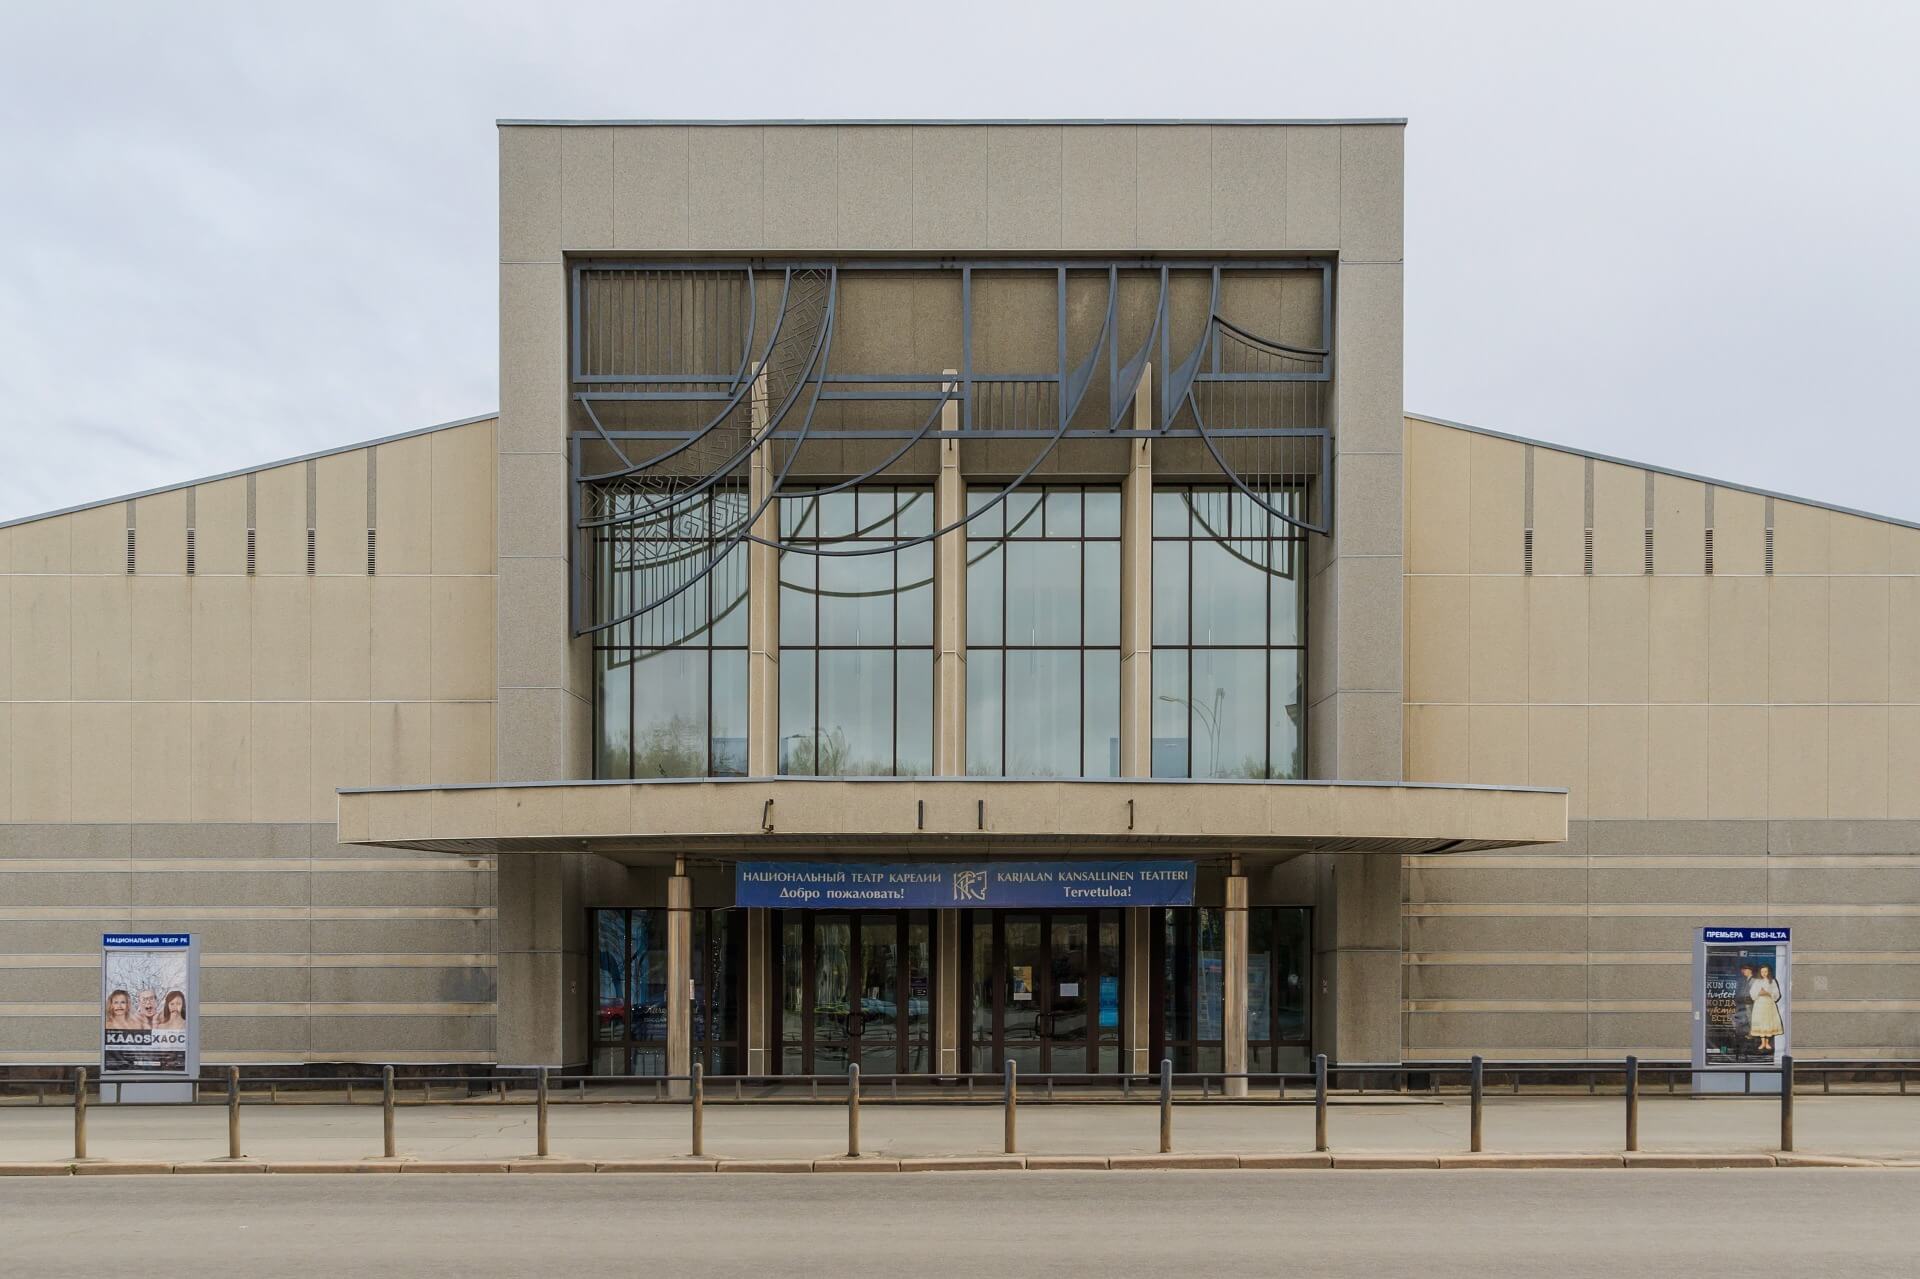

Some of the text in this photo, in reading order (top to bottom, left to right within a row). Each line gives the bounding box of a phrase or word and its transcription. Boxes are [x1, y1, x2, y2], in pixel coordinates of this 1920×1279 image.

[743, 872, 942, 883] НАЦИОНАЛЬНЫЙ ТЕАТР КАРЕЛИИ
[998, 870, 1188, 883] KARJALAN KANSALLINEN TEATTERI
[779, 888, 905, 901] Добро пожаловать!
[1064, 886, 1132, 897] Tervetuloa!
[1750, 931, 1786, 939] ENSI-ILTA
[106, 1033, 151, 1043] KAAOS
